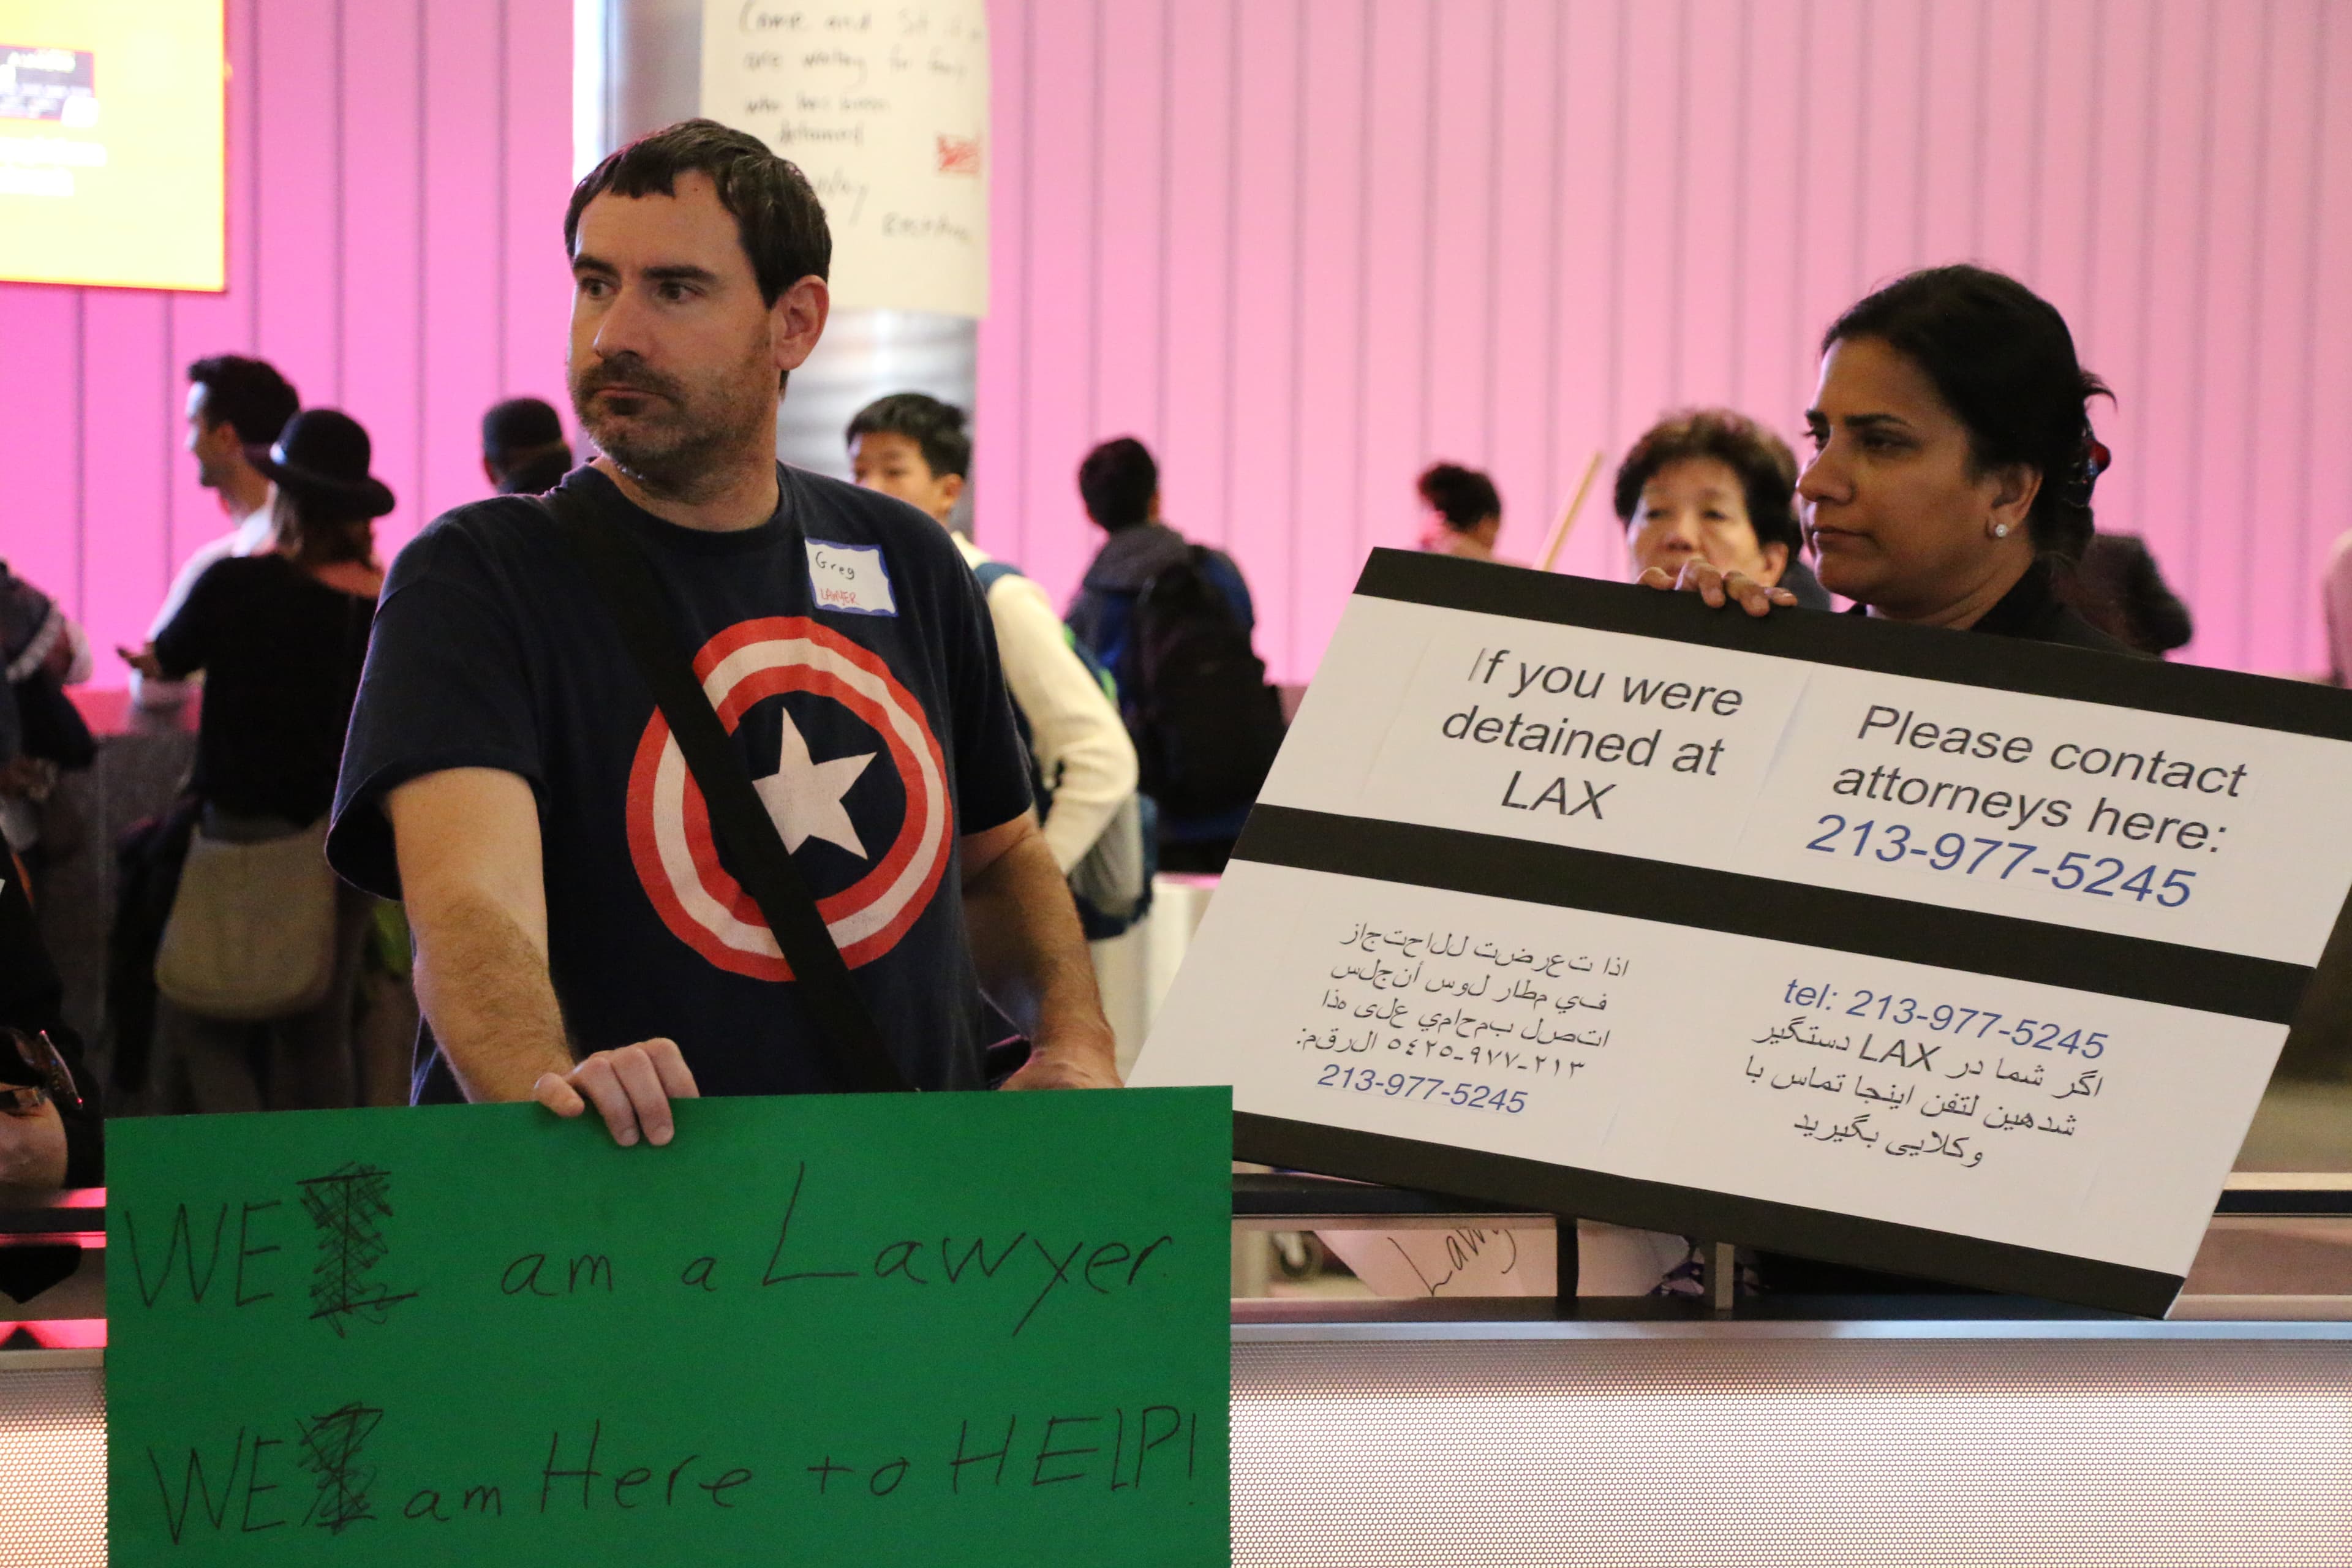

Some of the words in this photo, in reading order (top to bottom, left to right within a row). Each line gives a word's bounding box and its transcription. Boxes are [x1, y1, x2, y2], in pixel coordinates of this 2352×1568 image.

[816, 551, 854, 580] Greg
[1468, 647, 1510, 684] If
[1509, 663, 1605, 698] you
[1623, 677, 1743, 716] were
[1442, 705, 1662, 767] detained
[1672, 739, 1725, 776] at
[1857, 705, 2033, 763] Please
[2050, 743, 2247, 797] contact
[1501, 771, 1617, 820] LAX
[1833, 765, 2071, 831] attorneys
[2087, 797, 2226, 853] here:
[1806, 814, 2196, 908] 213-977-5245
[1784, 979, 1838, 1011] tel:
[1846, 989, 2109, 1059] 213-977-5245
[1858, 1033, 1942, 1072] LAX
[1317, 1064, 1528, 1114] 213-977-5245
[124, 1199, 282, 1308] WE
[500, 1253, 614, 1297] am
[680, 1254, 719, 1292] a
[147, 1426, 286, 1545] WE
[404, 1484, 502, 1522] am
[540, 1418, 752, 1509] Here
[806, 1455, 911, 1496] to
[949, 1405, 1198, 1506] HELP!
